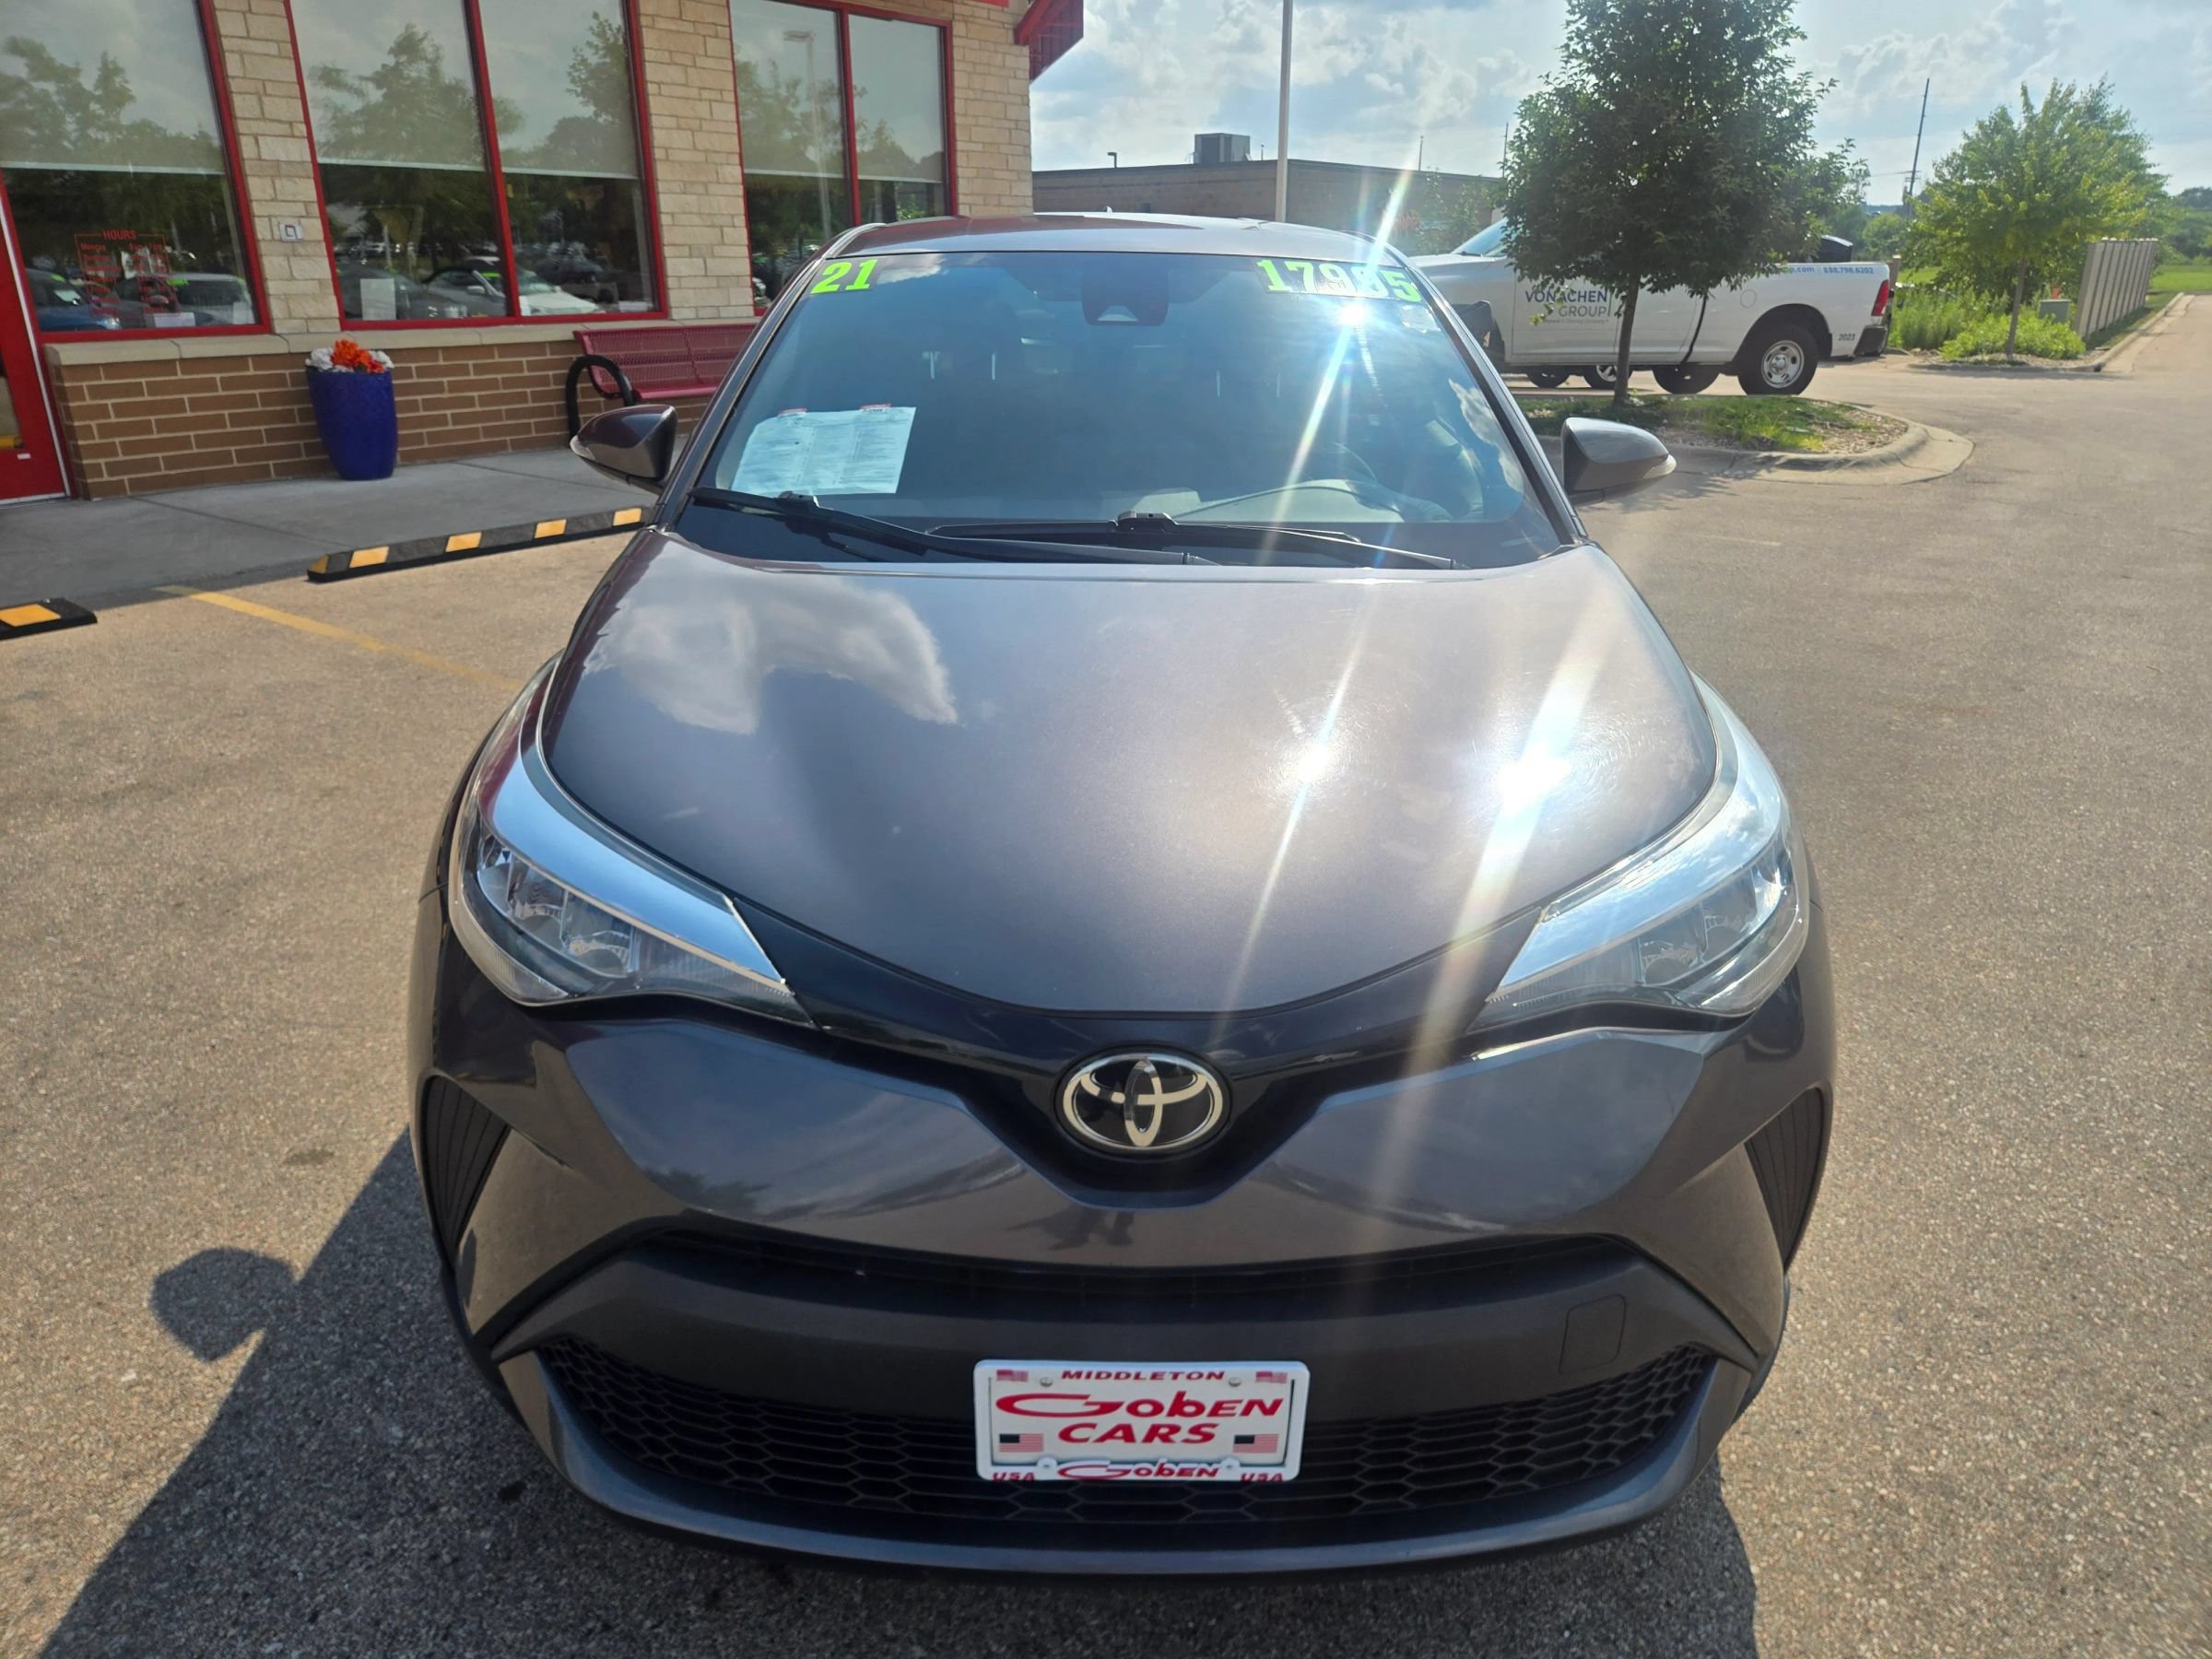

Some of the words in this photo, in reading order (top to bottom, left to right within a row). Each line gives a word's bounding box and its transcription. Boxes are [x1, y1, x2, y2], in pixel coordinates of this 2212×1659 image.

[102, 229, 137, 241] HOURS
[810, 259, 878, 295] 21
[1524, 289, 1608, 303] VONACHEN
[1558, 305, 1607, 318] GROUP
[1061, 1370, 1225, 1382] MIDDLETON
[1057, 1422, 1220, 1444] CARS
[992, 1471, 1036, 1483] USA
[1239, 1472, 1284, 1483] USA
